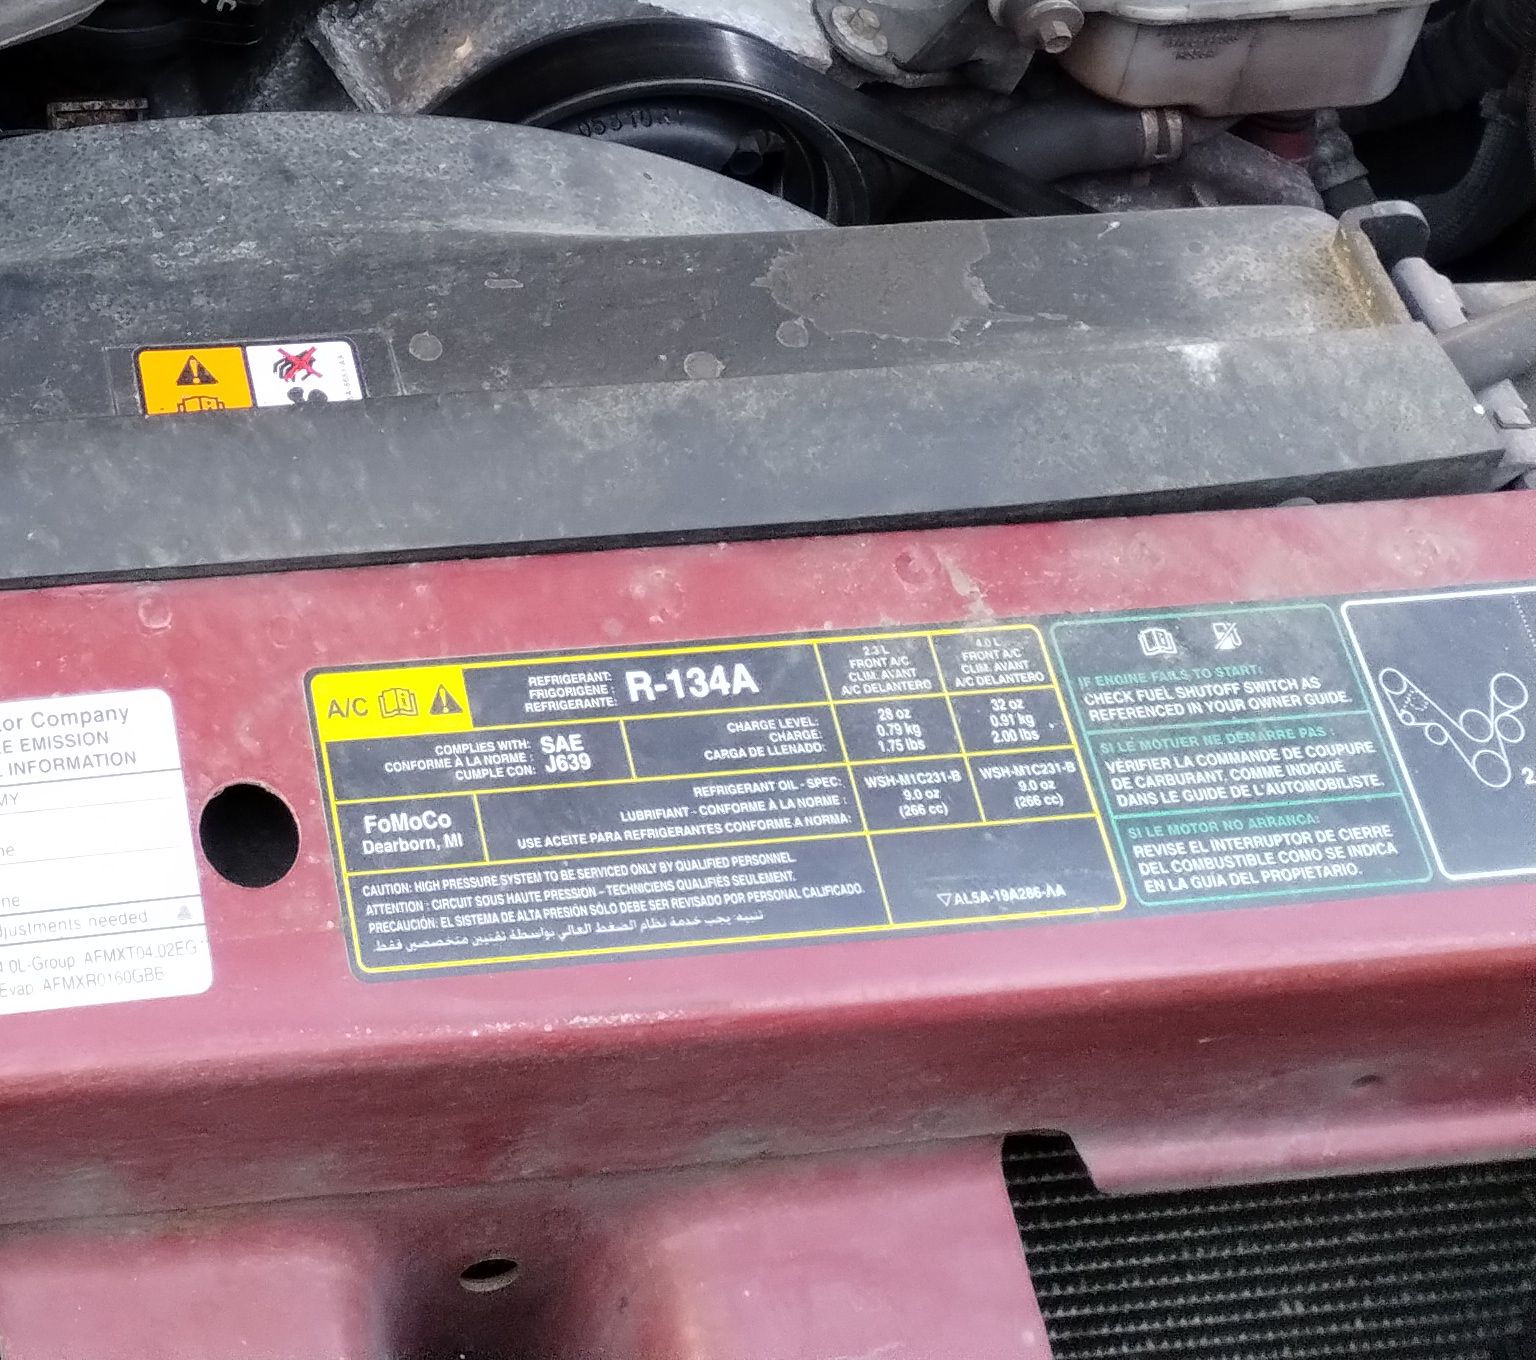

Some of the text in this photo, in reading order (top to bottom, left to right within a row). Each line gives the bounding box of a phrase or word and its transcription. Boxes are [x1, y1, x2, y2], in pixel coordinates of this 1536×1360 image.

[848, 657, 886, 669] FRONT
[961, 649, 999, 662] FRONT
[624, 662, 759, 702] R-134A
[861, 678, 932, 694] DELANTERO
[975, 671, 1045, 686] DELANTERO
[1083, 676, 1321, 706] CHECK FUEL SHUTOFF SWITCH AS
[326, 697, 369, 719] A/C
[877, 707, 911, 721] 28 oz
[990, 698, 1024, 712] 32 oz
[1088, 690, 1352, 722] REFERENCED IN YOUR OWNER GUIDE.
[30, 706, 129, 730] Company
[726, 715, 819, 733] CHARGE LEVEL:
[989, 712, 1035, 729] 0.91 kg
[875, 721, 922, 739] 0.79 kg
[990, 726, 1040, 743] 2.00 lbs
[19, 731, 109, 753] EMISSION
[434, 738, 531, 756] COMPLIES WITH:
[539, 733, 584, 753] SAE
[877, 736, 926, 753] 1.75 lbs
[8, 750, 137, 776] INFORMATION
[544, 752, 592, 772] J639
[703, 747, 743, 761] CARGA
[742, 746, 764, 757] DE
[1172, 755, 1194, 768] LA
[1195, 748, 1280, 766] COMMANDE
[1280, 746, 1303, 760] DE
[1304, 741, 1376, 758] COUPURE
[454, 764, 536, 781] CUMPLE CON:
[863, 769, 962, 788] WSH-M1C231-B
[979, 761, 1076, 779] WSH-M1C231-B
[1110, 777, 1133, 790] DE
[1228, 765, 1284, 781] COMME
[692, 780, 776, 797] REFRIGERANT
[777, 779, 798, 791] OIL
[902, 788, 941, 801] 9.0 oz
[1017, 779, 1056, 792] 9.0 oz
[1013, 793, 1064, 809] (266 cc)
[1116, 791, 1159, 807] DANS
[1159, 790, 1180, 804] LE
[1181, 786, 1228, 802] GUIDE
[1228, 784, 1251, 798] DE
[898, 801, 949, 819] (266 cc)
[363, 809, 452, 834] FoMoCo
[1127, 827, 1142, 839] SI
[1144, 825, 1164, 837] LE
[1166, 820, 1219, 835] MOTOR
[1221, 819, 1244, 831] NO
[361, 832, 463, 855] Dearborn, MI
[1132, 824, 1393, 858] REVISE EL INTERRUPTOR DE CIERRE
[1137, 841, 1398, 875] DEL COMBUSTIBLE COMO SE INDICA
[361, 882, 413, 897] CAUTION:
[414, 879, 441, 893] HIGH
[441, 874, 499, 890] PRESSURE
[499, 871, 542, 887] SYSTEM
[543, 870, 559, 882] TO
[559, 868, 577, 881] BE
[576, 864, 629, 880] SERVICED
[629, 862, 657, 875] ONLY
[658, 860, 674, 873] BY
[674, 856, 730, 872] QUALIFIED
[1143, 879, 1166, 893] EN
[1167, 877, 1189, 891] LA
[1228, 871, 1259, 885] DEL
[1260, 862, 1362, 882] PROPIETARIO.
[87, 909, 148, 928] needed
